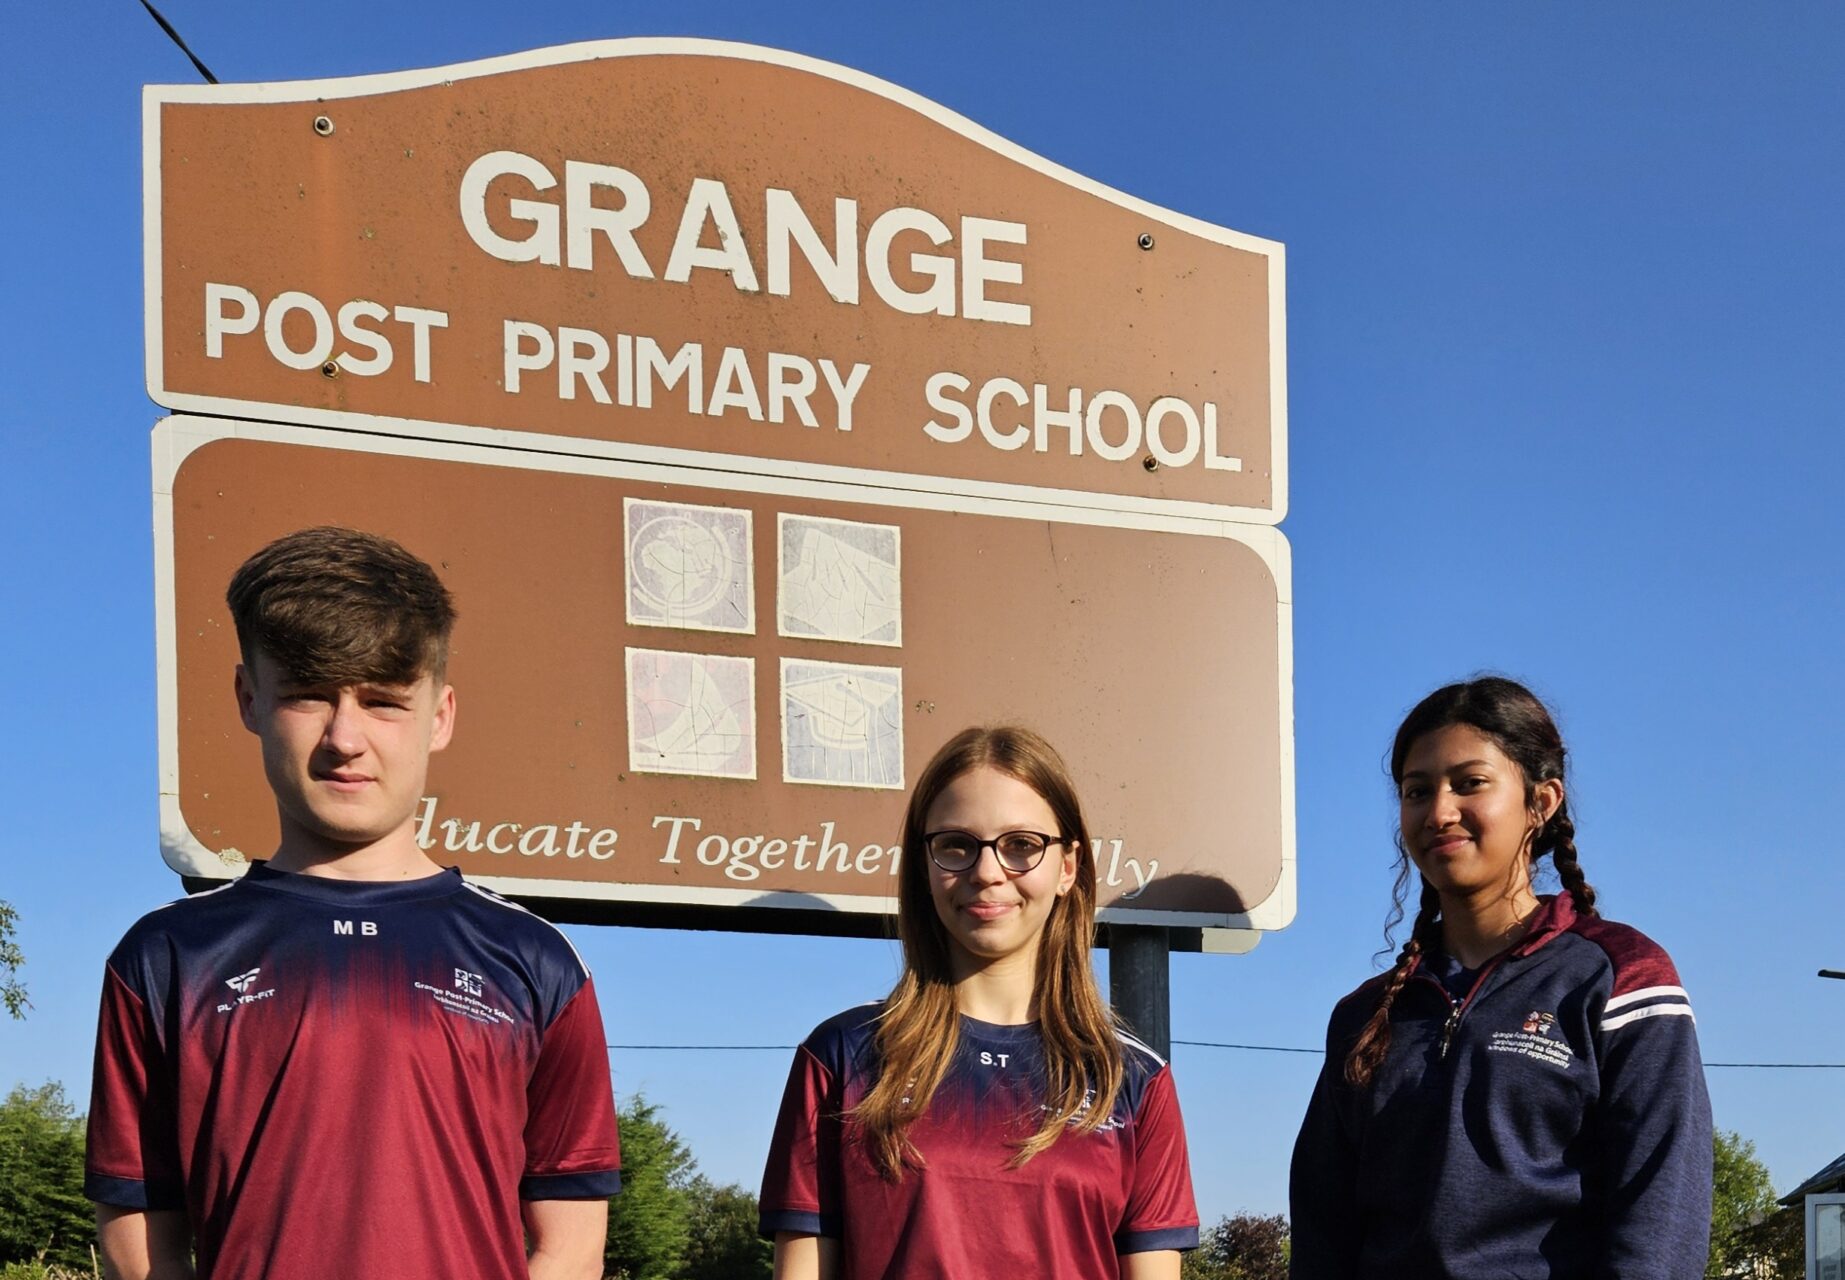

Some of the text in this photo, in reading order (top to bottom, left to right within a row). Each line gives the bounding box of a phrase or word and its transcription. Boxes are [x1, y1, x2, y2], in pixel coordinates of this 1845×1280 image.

[459, 150, 1032, 327] GRANGE
[205, 282, 1242, 473] POST PRIMARY SCHOOL
[414, 797, 903, 881] ducate Together
[333, 919, 378, 936] M B
[414, 981, 444, 995] Grange
[1527, 1050, 1570, 1069] opportunity
